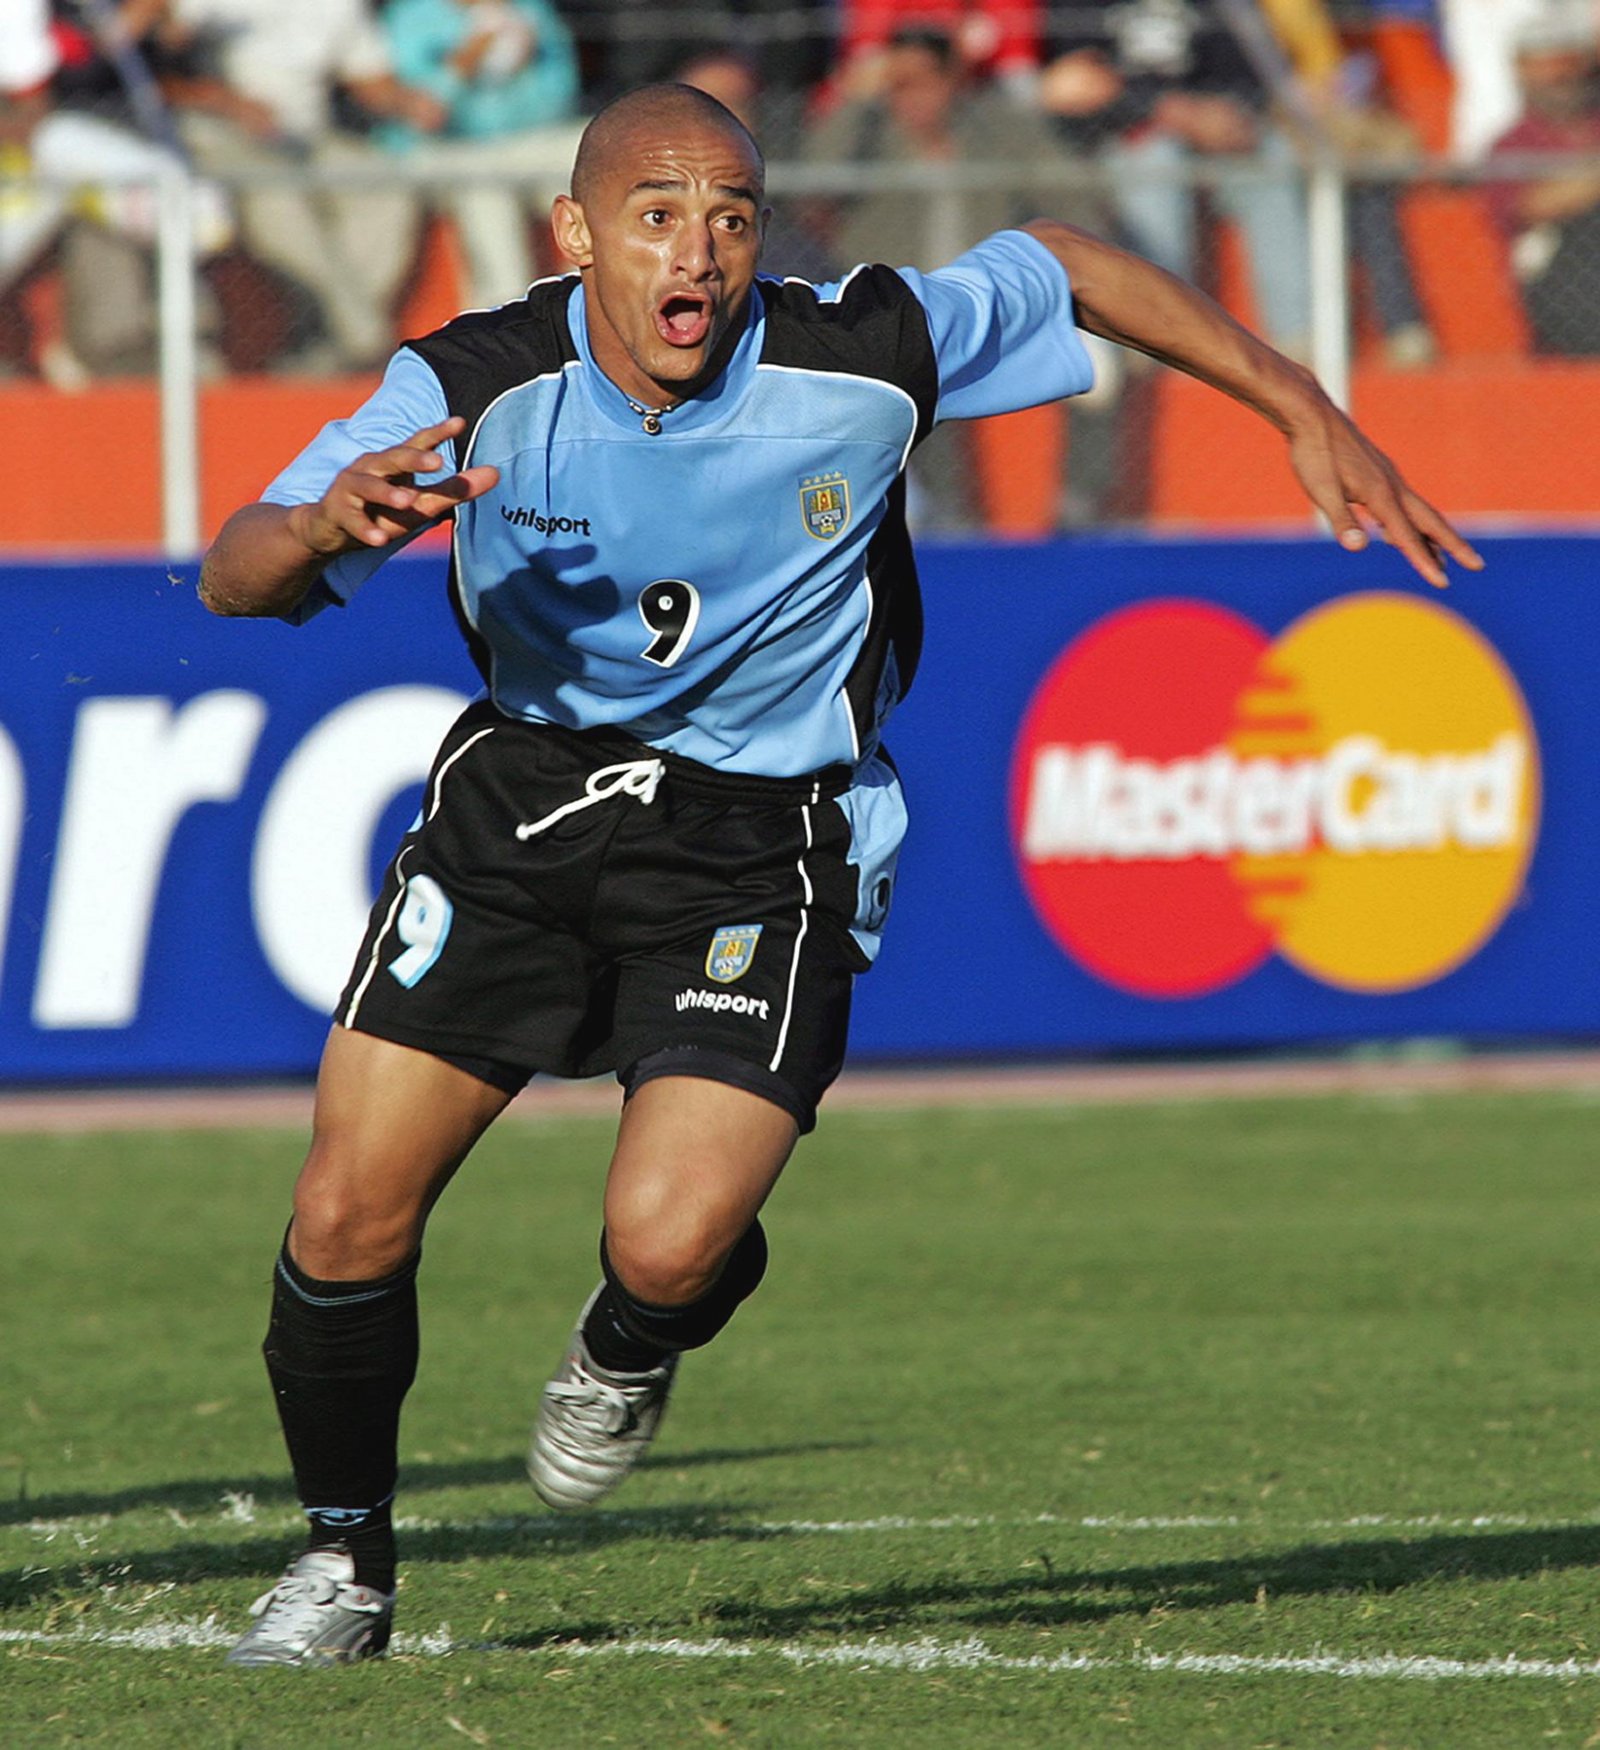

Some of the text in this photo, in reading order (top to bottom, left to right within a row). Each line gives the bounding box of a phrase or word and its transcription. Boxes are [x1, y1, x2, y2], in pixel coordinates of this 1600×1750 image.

[500, 504, 591, 538] uhlsport
[638, 579, 700, 668] 9
[1022, 735, 1527, 860] MasterCard
[387, 873, 454, 989] 9
[675, 988, 770, 1021] uhlsport
